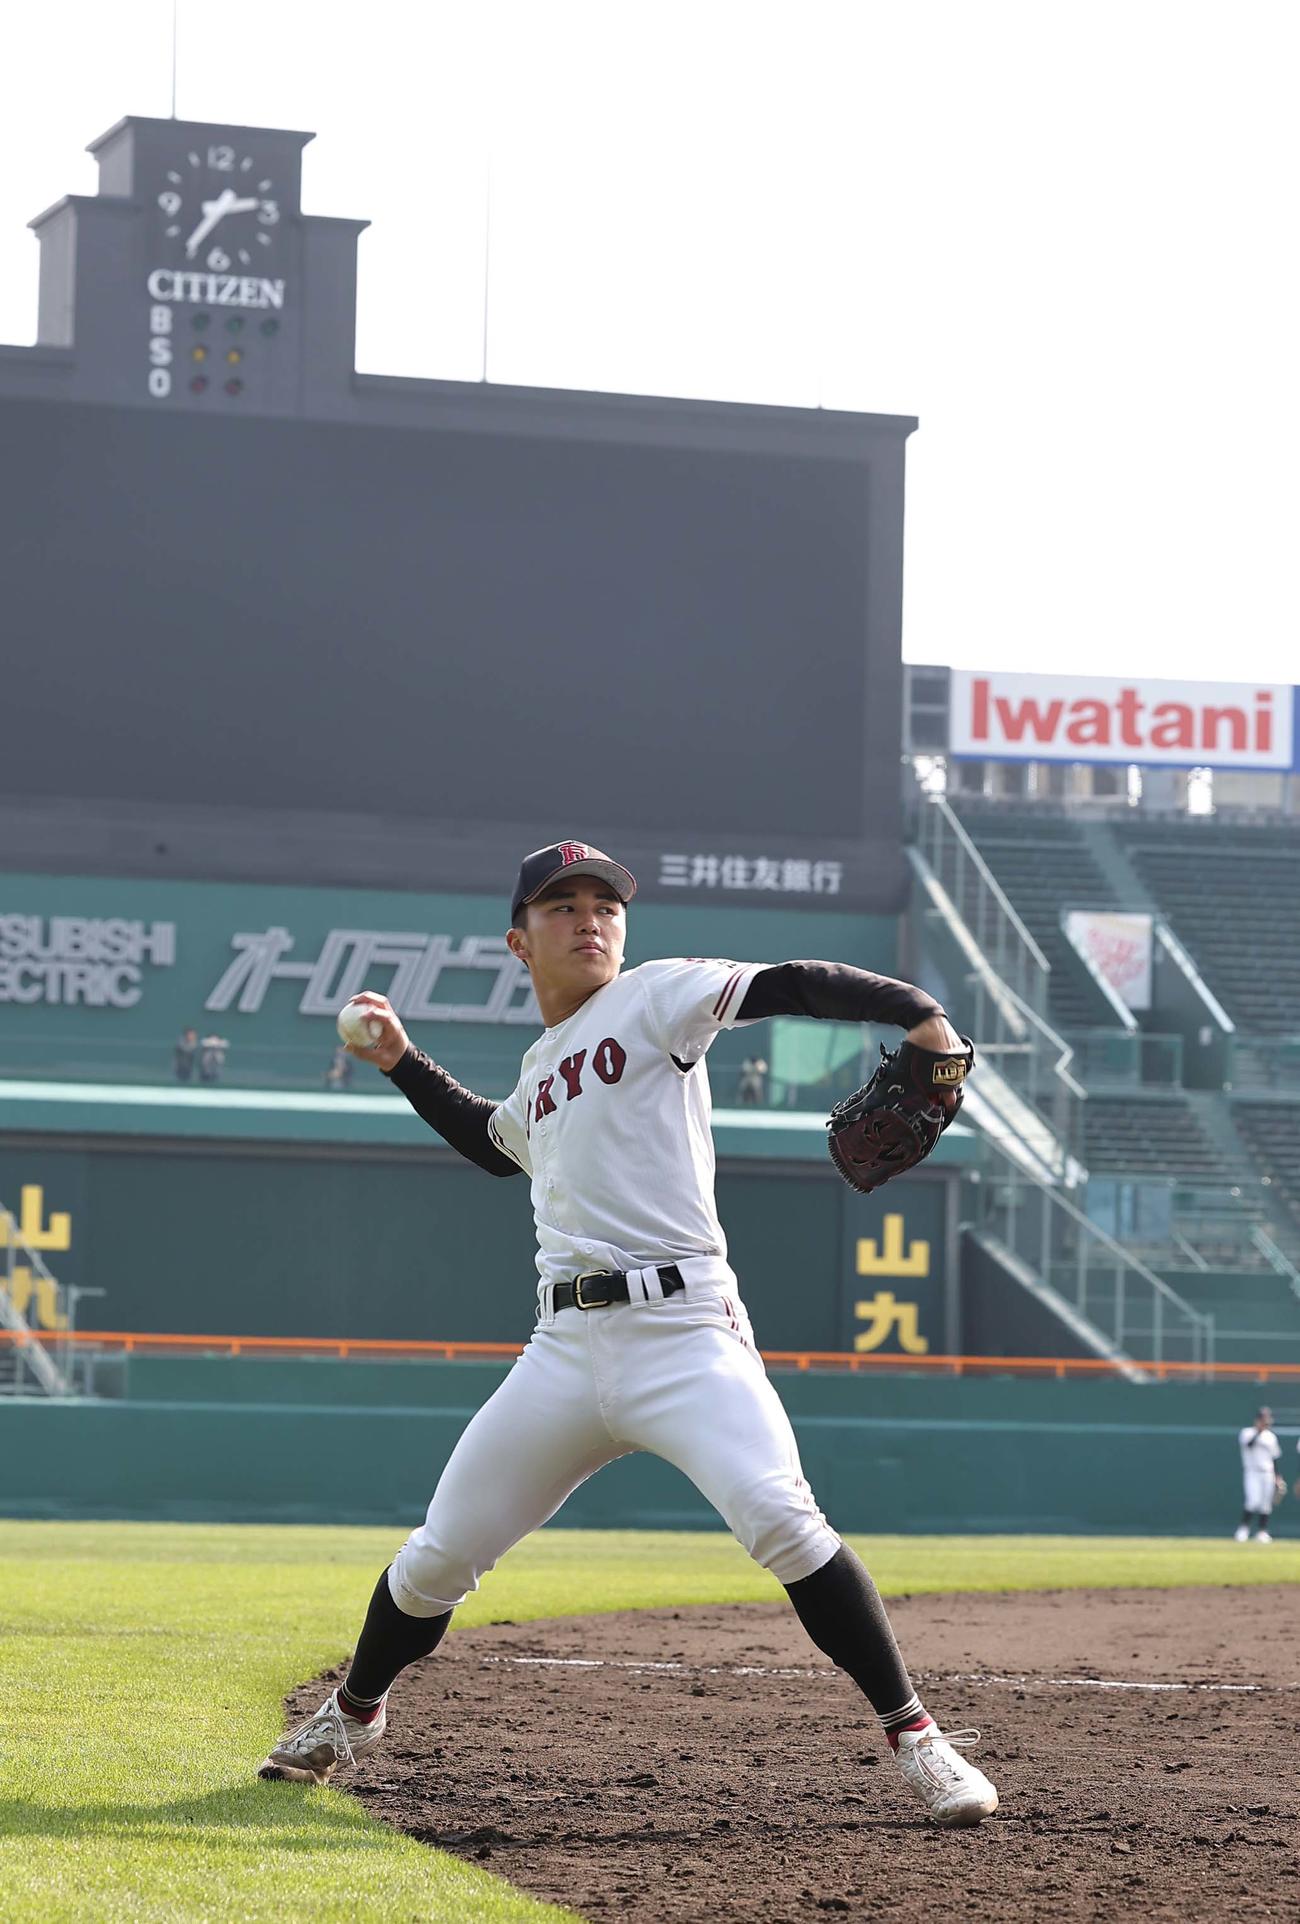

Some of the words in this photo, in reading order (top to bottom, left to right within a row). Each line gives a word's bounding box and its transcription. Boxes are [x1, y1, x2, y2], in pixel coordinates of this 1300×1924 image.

[207, 145, 236, 171] 12
[157, 191, 182, 217] 9
[257, 199, 280, 225] 3
[206, 246, 231, 272] 6
[147, 268, 286, 309] CITIZEN
[970, 678, 1274, 752] Iwatani
[658, 854, 842, 895] 三井住友銀行
[854, 1213, 930, 1354] 山九
